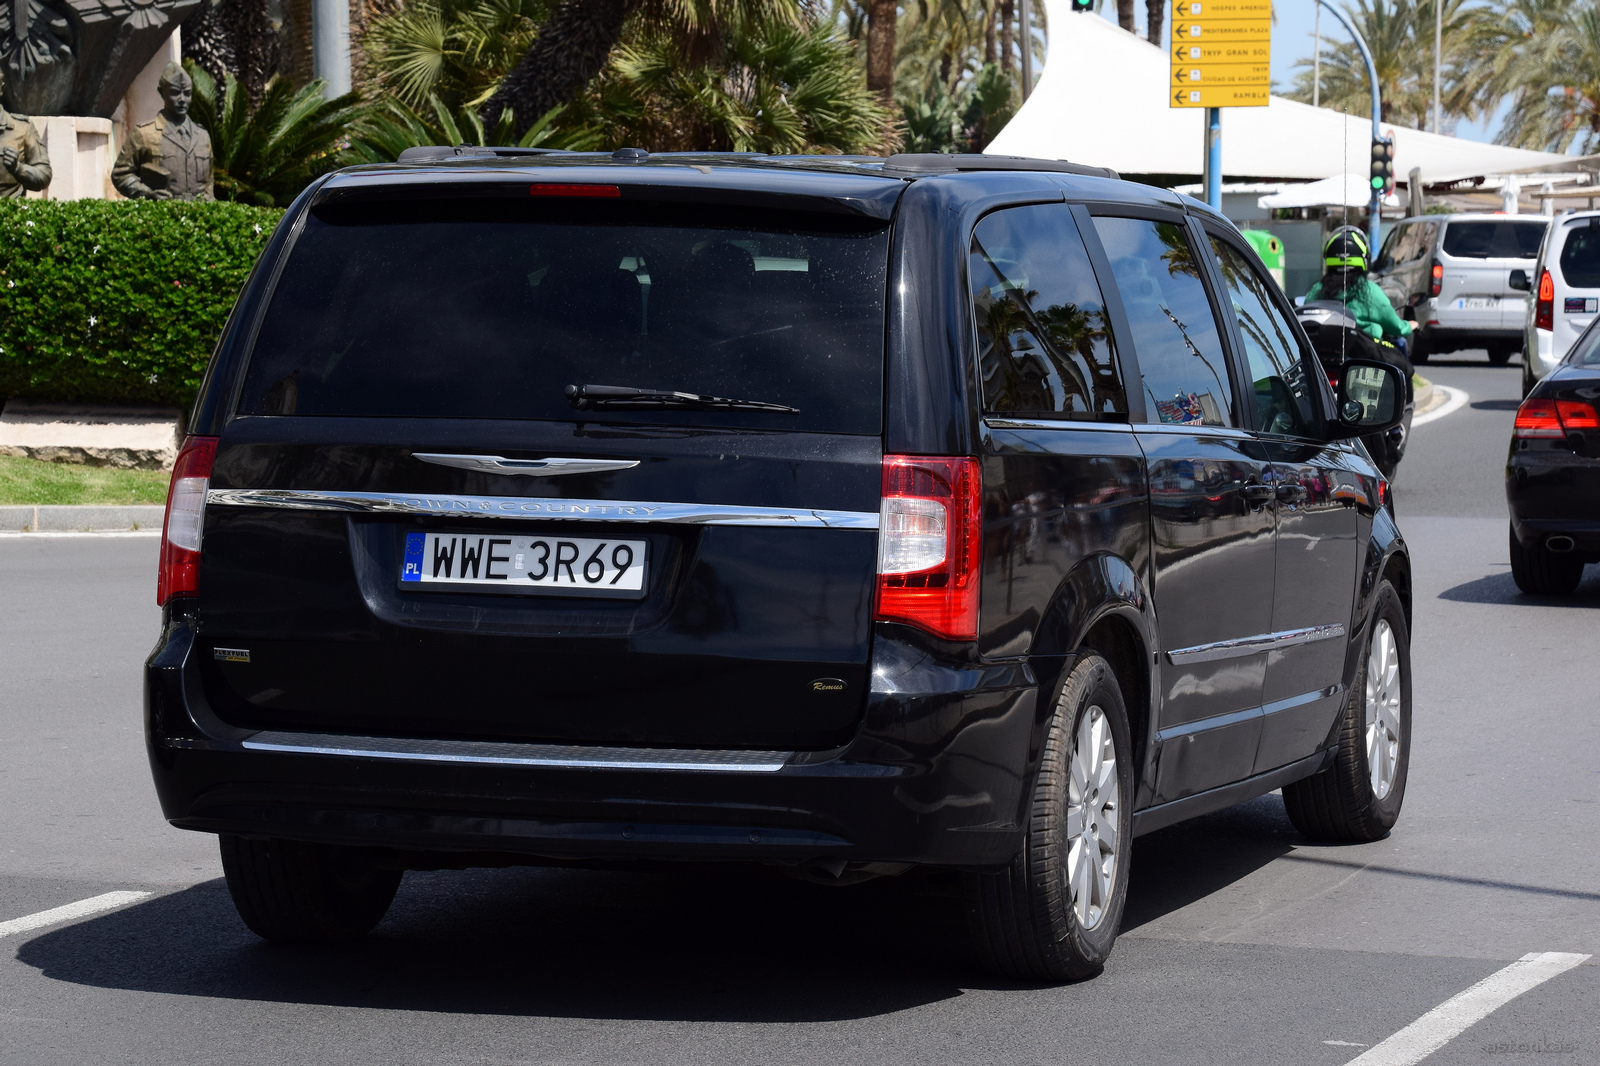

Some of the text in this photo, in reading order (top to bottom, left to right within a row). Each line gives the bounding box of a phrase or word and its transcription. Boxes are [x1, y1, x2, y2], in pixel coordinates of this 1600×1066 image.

[432, 537, 634, 585] WWE 3R69
[405, 562, 420, 575] PL
[813, 682, 843, 691] Remus
